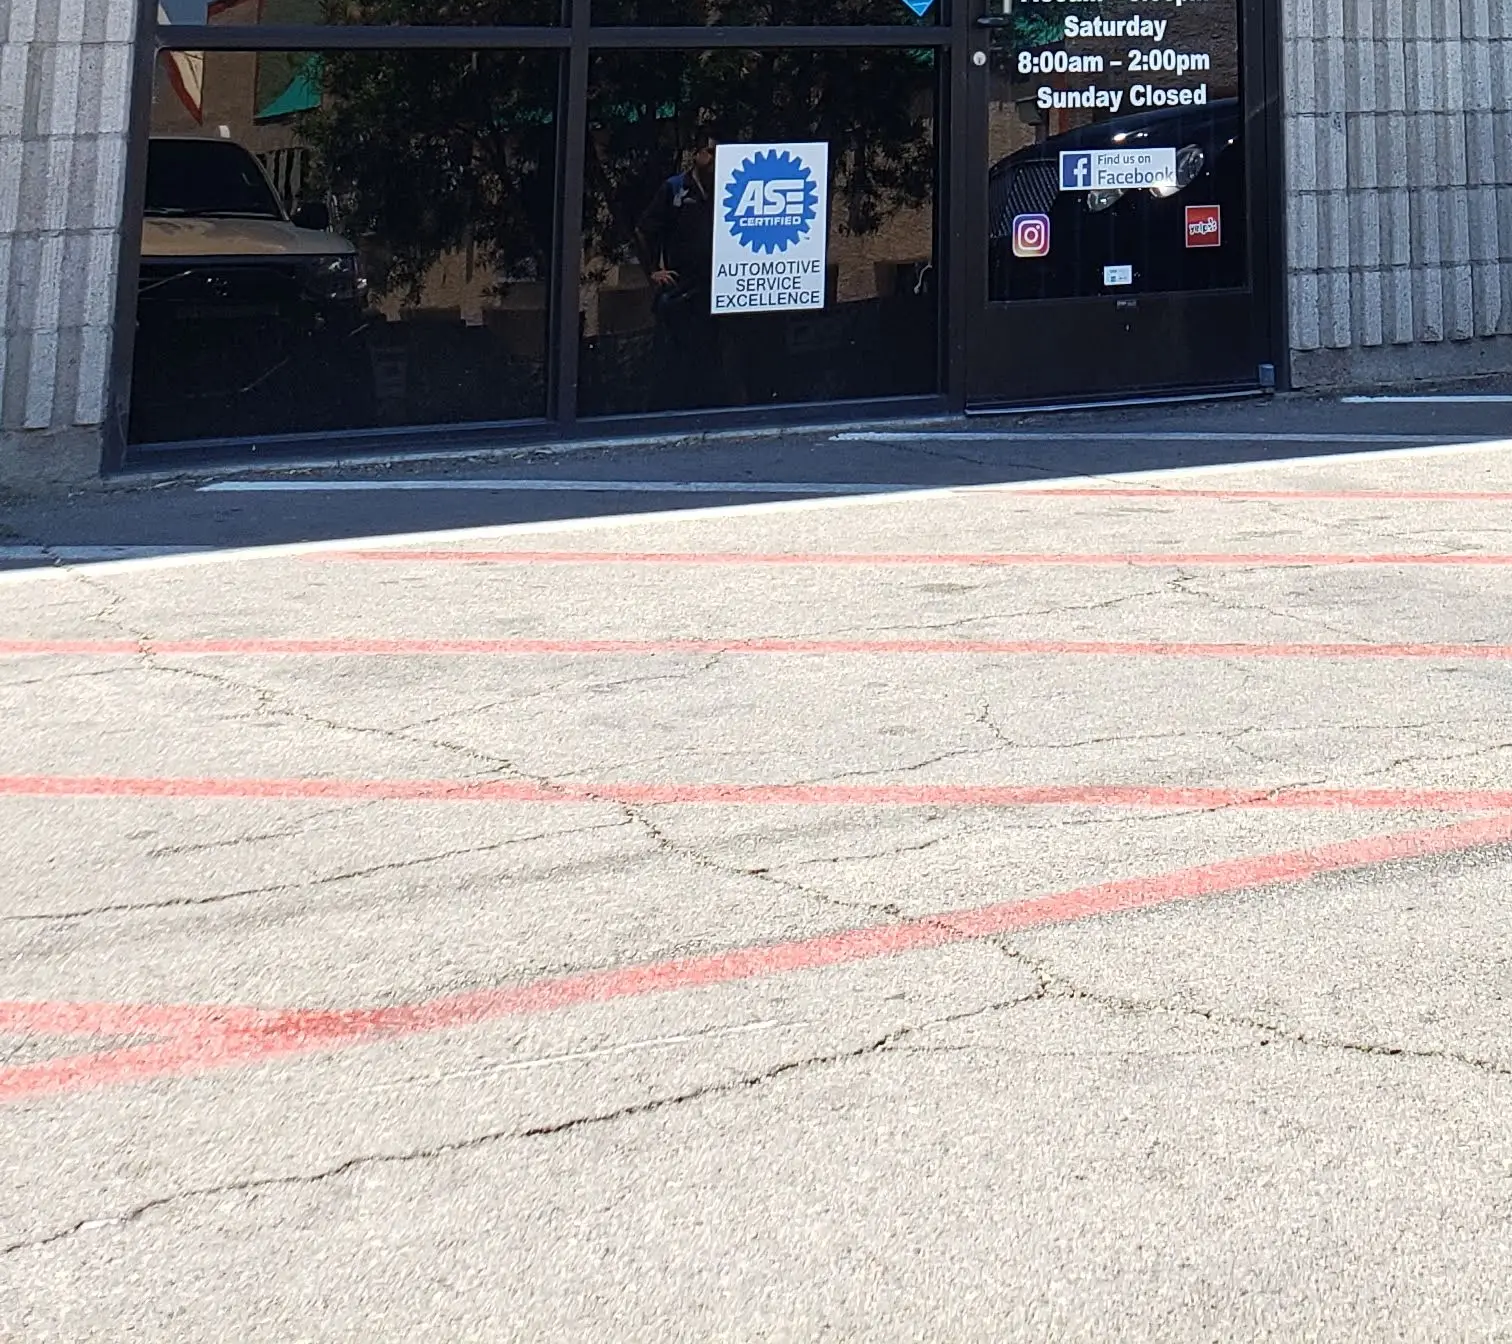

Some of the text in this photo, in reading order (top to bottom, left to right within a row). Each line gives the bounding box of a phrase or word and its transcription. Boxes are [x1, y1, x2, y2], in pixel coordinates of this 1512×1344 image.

[1064, 15, 1167, 42] Saturday
[1017, 50, 1104, 74] 8:00am
[1127, 50, 1210, 77] 2:00pm
[1036, 83, 1207, 112] Sunday Closed
[1098, 154, 1151, 165] Find us on
[1098, 167, 1174, 185] Facebook
[734, 179, 805, 216] ASE
[739, 216, 802, 227] CERTIFIED
[717, 260, 820, 277] AUTOMOTIVE
[736, 276, 801, 292] SERVICE
[716, 291, 820, 308] EXCELLENCE
